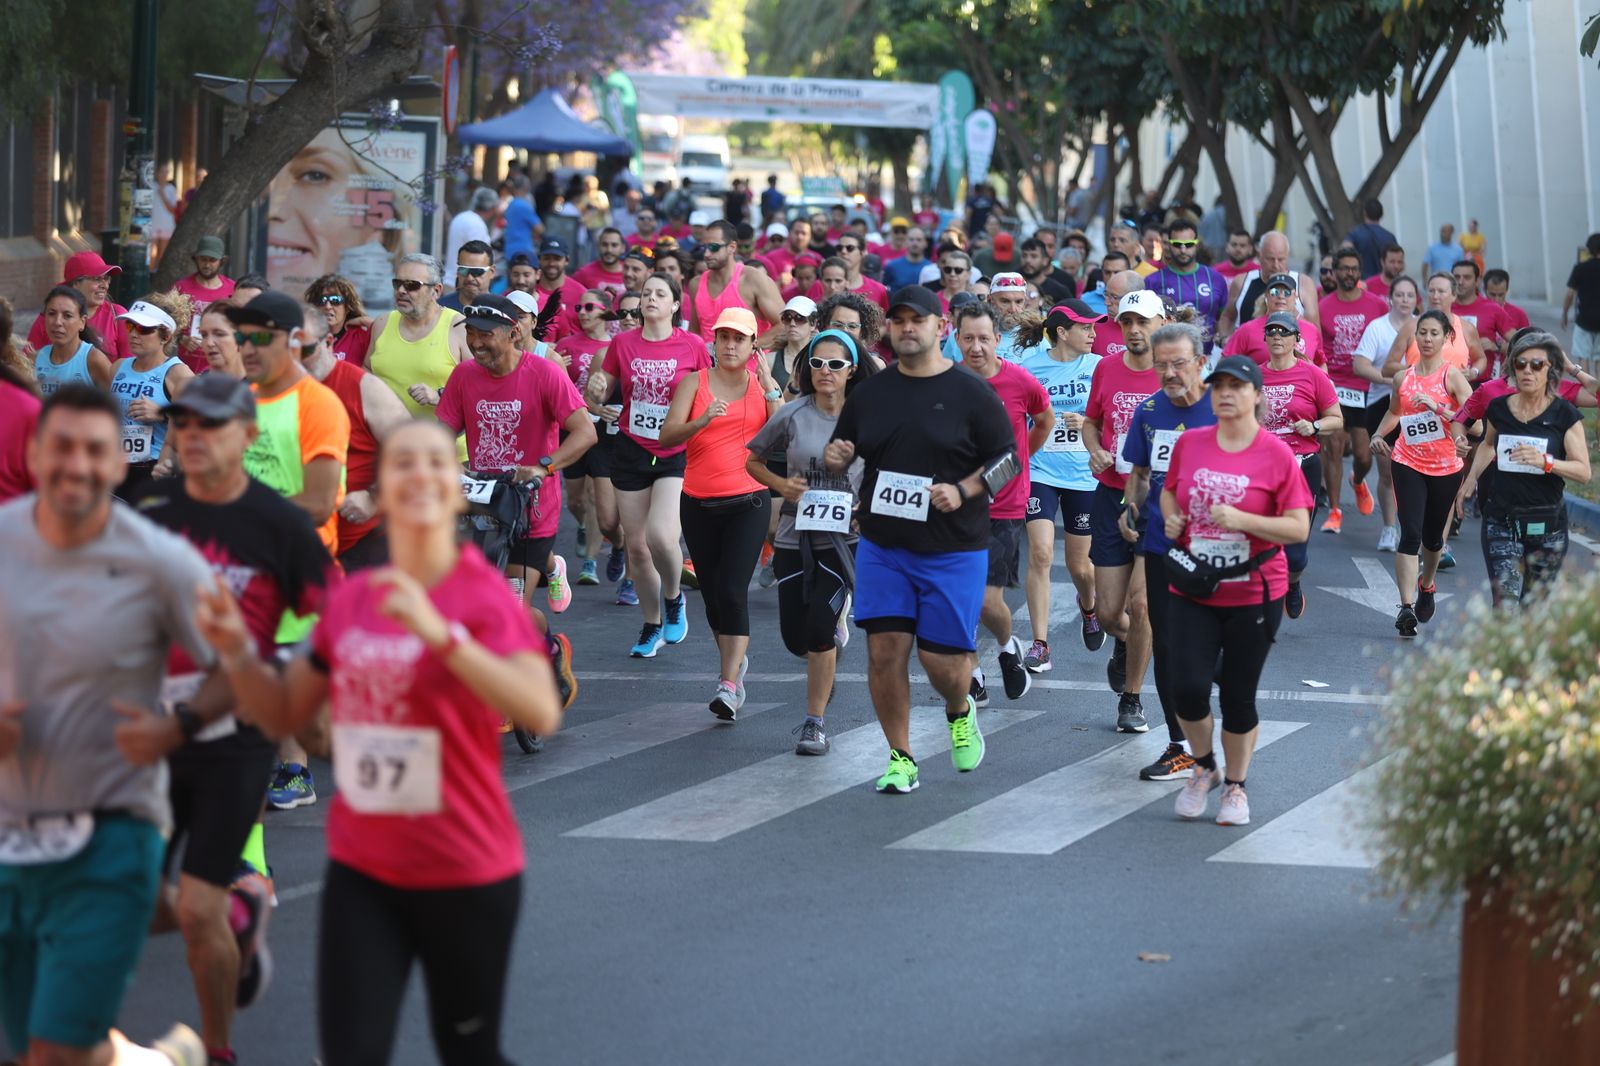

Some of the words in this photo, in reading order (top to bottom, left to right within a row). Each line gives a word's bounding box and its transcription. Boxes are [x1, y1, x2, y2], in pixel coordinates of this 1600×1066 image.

[1054, 429, 1079, 443] 26
[1406, 420, 1439, 437] 698
[879, 487, 923, 508] 404
[802, 504, 846, 520] 476
[1168, 548, 1197, 572] adidas
[356, 753, 406, 790] 97
